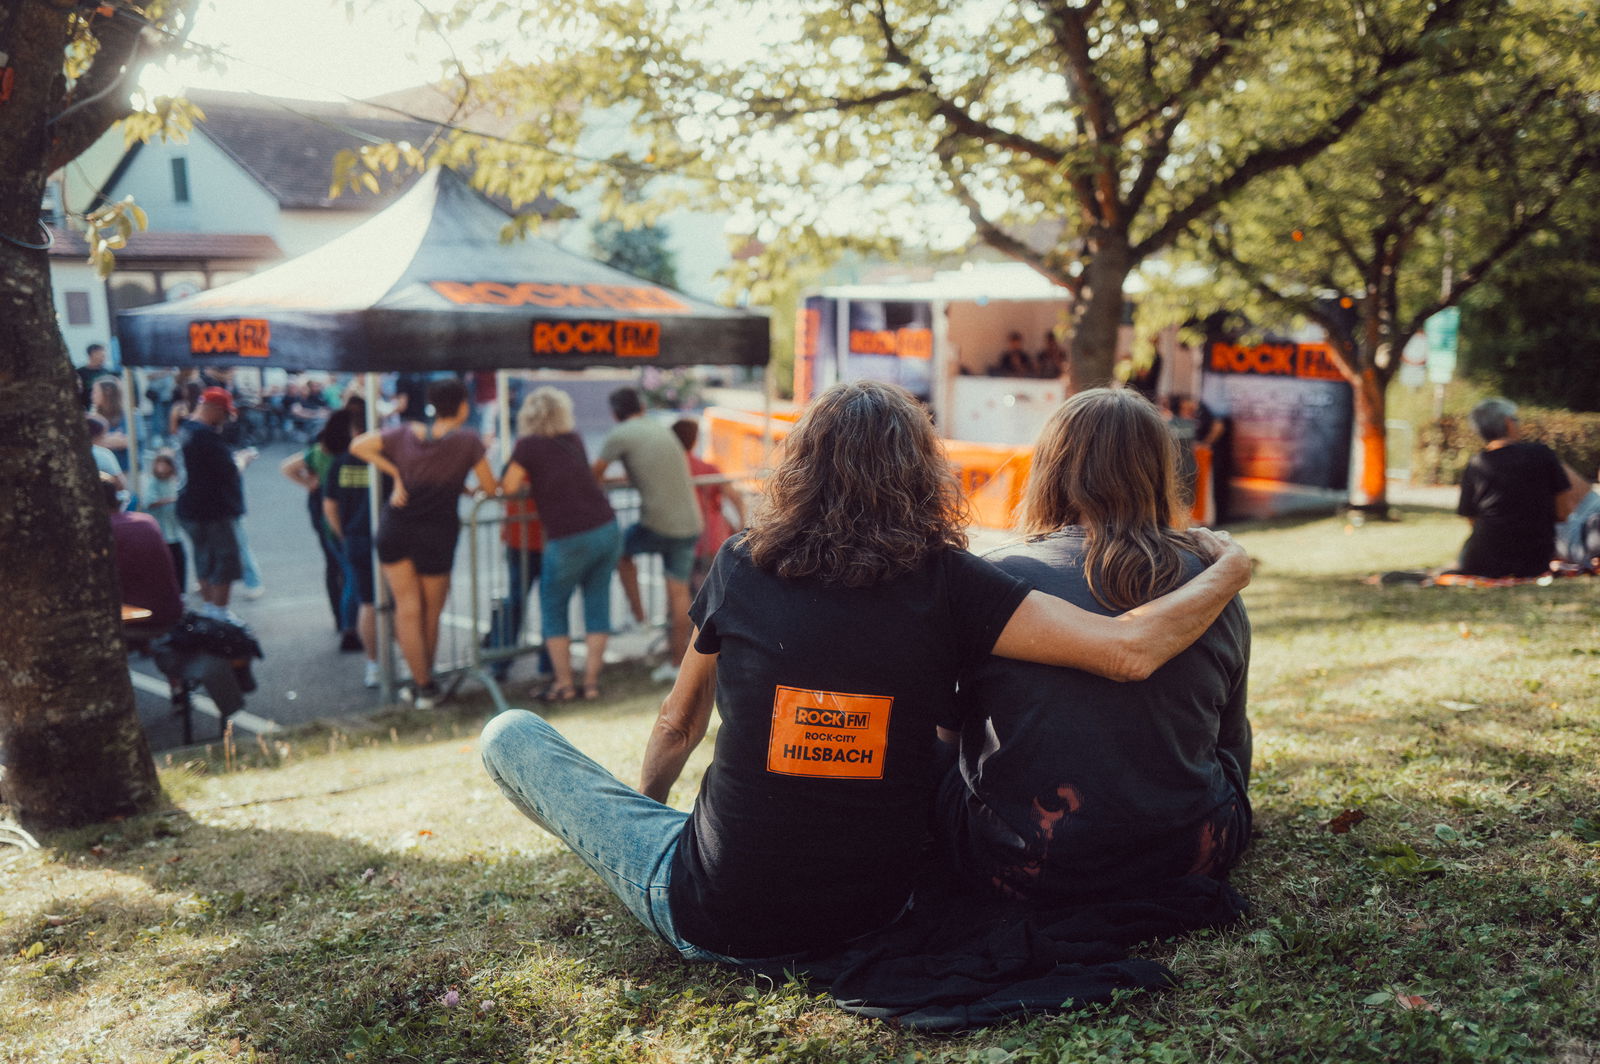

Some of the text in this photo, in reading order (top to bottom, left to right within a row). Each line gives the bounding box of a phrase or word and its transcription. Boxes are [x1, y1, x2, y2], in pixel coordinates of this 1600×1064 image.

[190, 322, 239, 353] ROCK
[533, 322, 614, 353] ROCK
[1211, 342, 1295, 374] ROCK
[797, 708, 867, 727] ROCK FM
[804, 731, 857, 743] ROCK-CITY
[783, 743, 874, 764] HILSBACH
